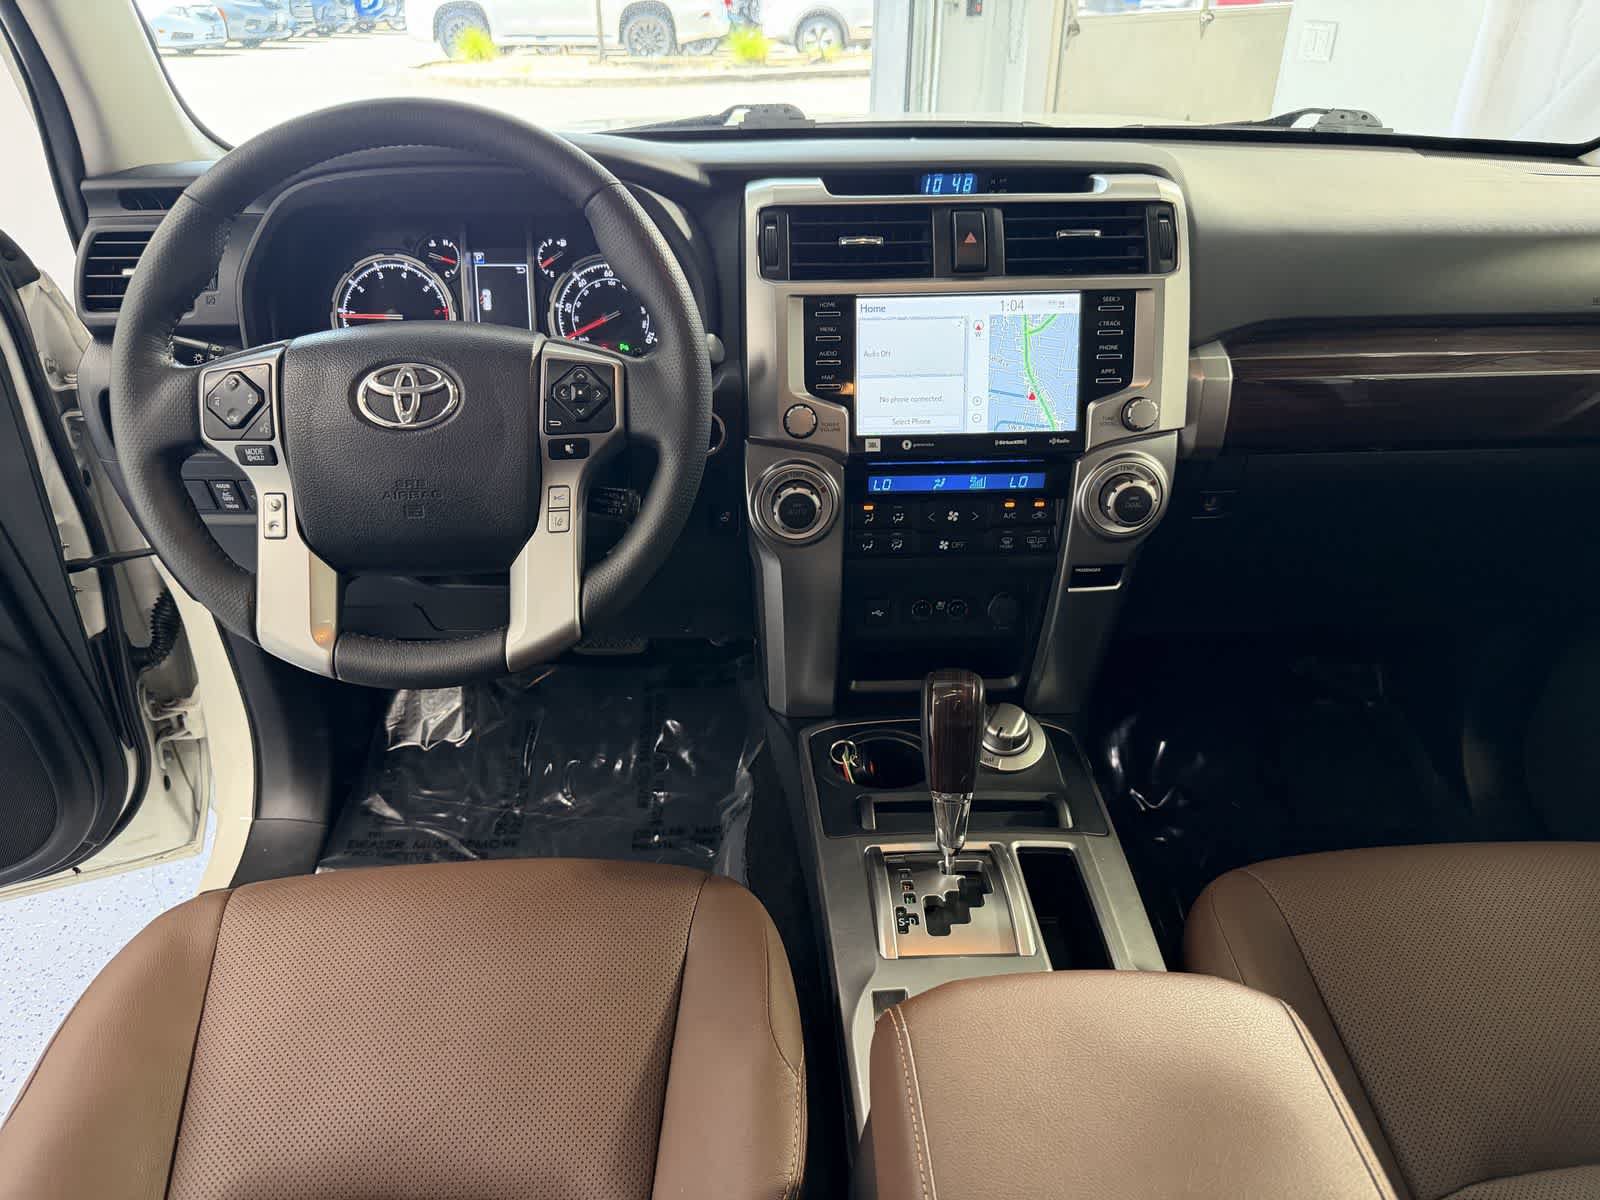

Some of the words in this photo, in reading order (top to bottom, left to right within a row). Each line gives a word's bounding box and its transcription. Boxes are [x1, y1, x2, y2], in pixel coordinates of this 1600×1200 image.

[860, 304, 886, 313] Home
[1000, 299, 1025, 312] 1:04
[873, 479, 892, 490] LO
[1009, 476, 1029, 487] LO
